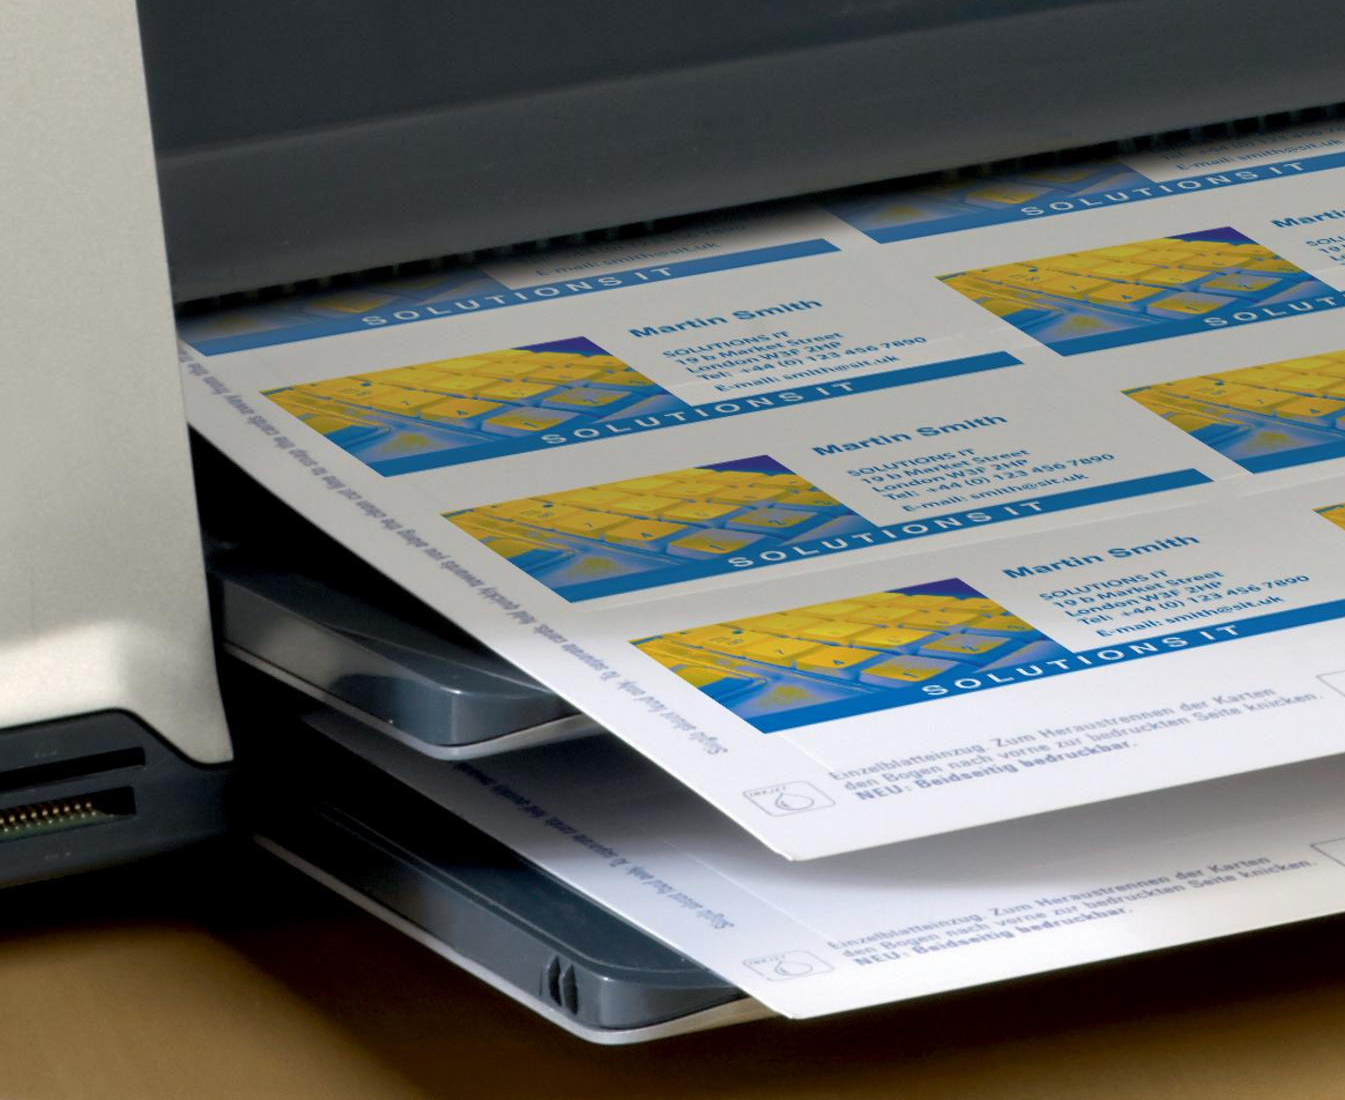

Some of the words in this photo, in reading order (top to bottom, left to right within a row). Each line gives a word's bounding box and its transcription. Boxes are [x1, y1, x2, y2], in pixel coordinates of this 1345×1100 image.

[1020, 171, 1259, 216] SOLUTIONS
[1269, 162, 1303, 175] IT
[1319, 246, 1341, 254] 19
[361, 277, 623, 325] SOLUTIONS
[635, 267, 672, 280] IT
[628, 317, 728, 338] Martin
[732, 300, 823, 320] Smith
[662, 335, 771, 358] SOLUTIONS
[772, 331, 789, 339] IT
[676, 357, 699, 365] 19
[718, 343, 785, 358] Market
[786, 333, 844, 346] Street
[715, 376, 780, 392] E-mail:
[783, 355, 900, 380] smith@sit.uk
[541, 392, 804, 444] SOLUTIONS
[816, 382, 853, 396] IT
[812, 434, 912, 456] Martin
[916, 416, 1008, 437] Smith
[847, 453, 956, 476] SOLUTIONS
[957, 449, 975, 457] IT
[861, 476, 884, 484] 19
[903, 460, 971, 477] Market
[972, 450, 1030, 464] Street
[872, 476, 946, 493] London
[945, 466, 985, 479] W3F
[991, 459, 1028, 471] 2HP
[883, 490, 919, 500] Tel:
[927, 482, 962, 492] +44
[964, 477, 991, 486] (0)
[993, 470, 1028, 480] 123
[1032, 463, 1066, 473] 456
[1067, 454, 1115, 467] 7890
[901, 496, 968, 512] E-mail:
[970, 473, 1088, 499] smith@sit.uk
[727, 512, 992, 567] SOLUTIONS
[1004, 501, 1042, 515] IT
[1003, 555, 1104, 579] Martin
[1108, 536, 1200, 558] Smith
[1039, 575, 1149, 600] SOLUTIONS
[1150, 570, 1168, 579] IT
[1054, 599, 1078, 608] 19
[1097, 583, 1164, 600] Market
[1165, 571, 1224, 586] Street
[1065, 599, 1140, 617] London
[1139, 589, 1179, 602] W3F
[1185, 581, 1222, 594] 2HP
[1077, 615, 1113, 625] Tel:
[1122, 606, 1156, 617] +44
[1158, 600, 1186, 610] (0)
[1187, 592, 1223, 604] 123
[1227, 585, 1261, 596] 456
[1262, 575, 1310, 589] 7890
[1096, 620, 1163, 637] E-mail:
[1165, 596, 1284, 623] smith@sit.uk
[922, 637, 1188, 696] SOLUTIONS
[1200, 625, 1238, 640] IT
[829, 743, 988, 781] Einzelblatteinzug.
[991, 732, 1036, 748] Zum
[1039, 706, 1175, 738] Heraustrennen
[1179, 699, 1208, 712] der
[1212, 687, 1276, 705] Karten
[843, 777, 878, 791] den
[882, 764, 942, 784] Bogen
[949, 753, 993, 771] nach
[999, 743, 1052, 759] vorne
[1057, 734, 1083, 747] zur
[1089, 717, 1189, 742] bedruckten
[1193, 705, 1242, 722] Seite
[1246, 691, 1324, 711] knicken.
[854, 785, 913, 801] NEU:
[914, 763, 1018, 789] Beidseitig
[1022, 740, 1138, 768] bedruckbar.
[853, 952, 911, 966] NEU:
[911, 928, 1015, 955] Beidseitig
[1019, 906, 1133, 934] bedruckbar.
